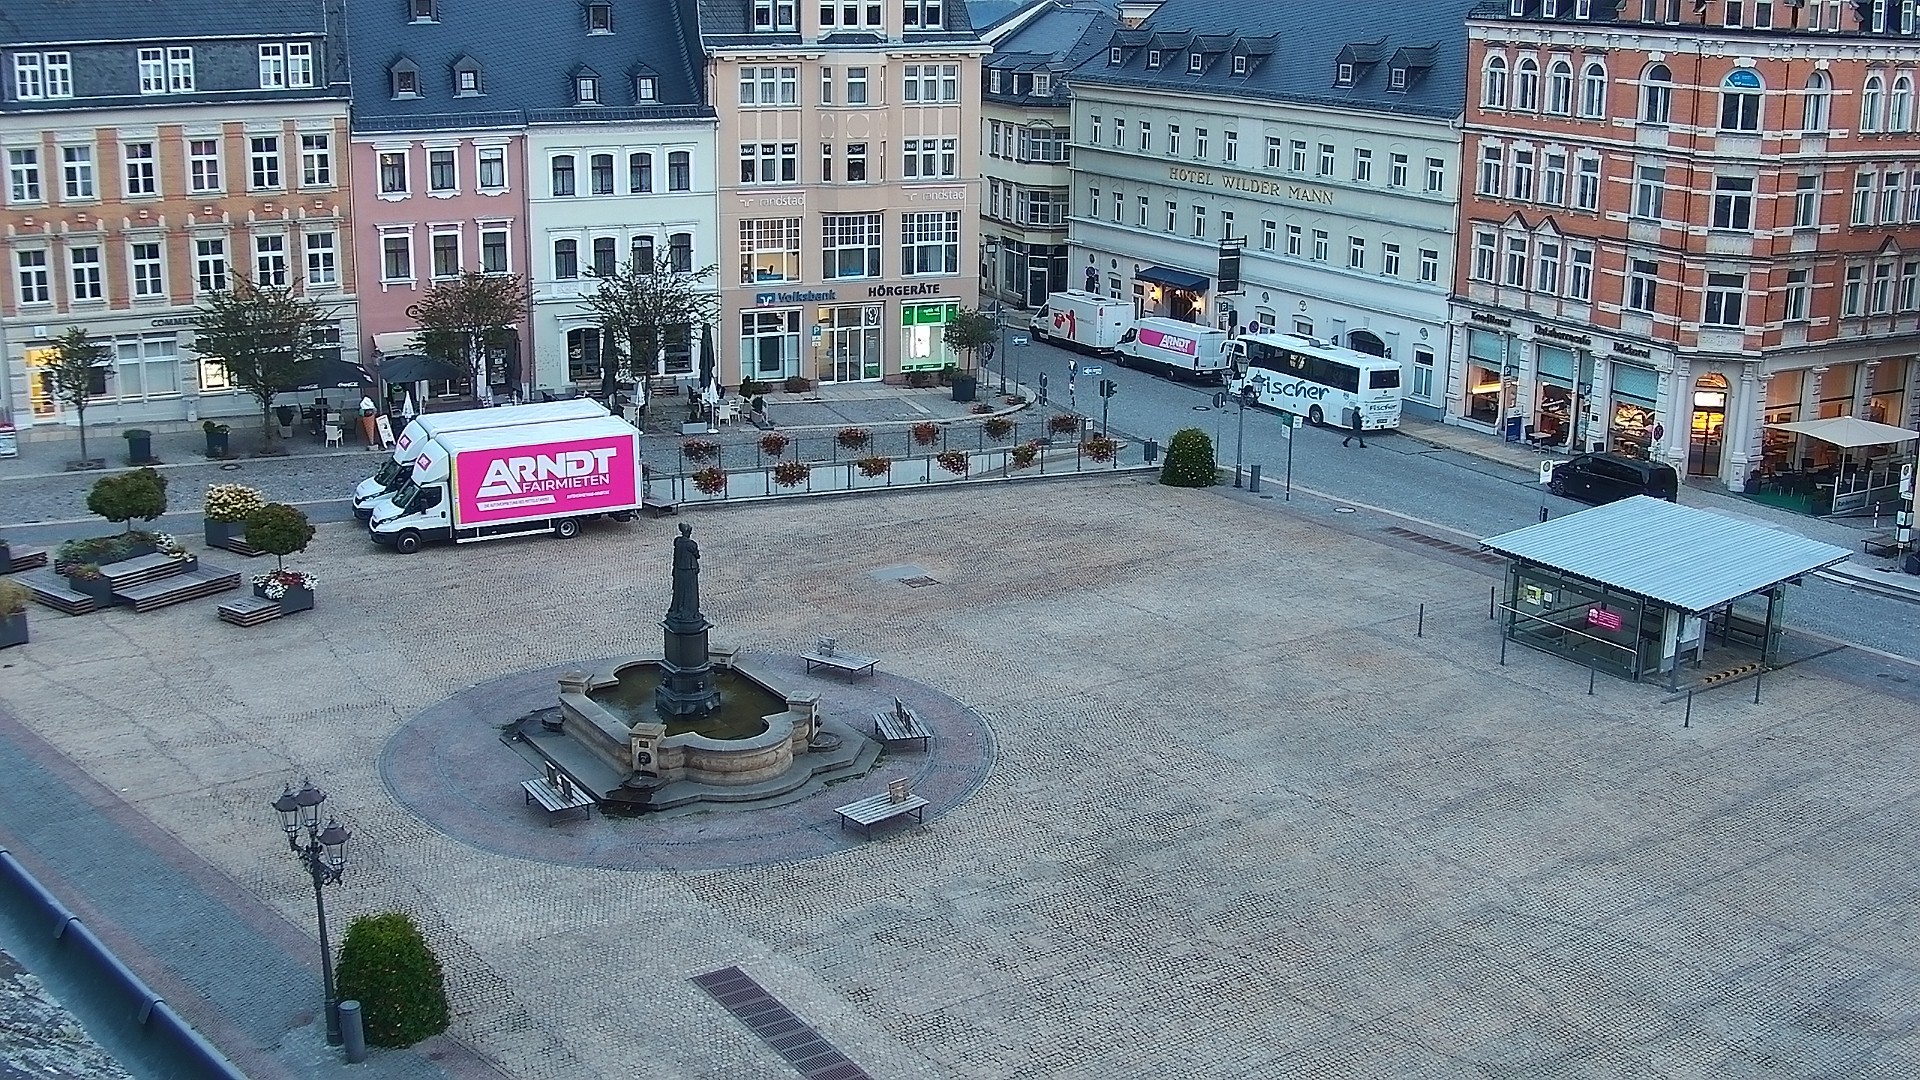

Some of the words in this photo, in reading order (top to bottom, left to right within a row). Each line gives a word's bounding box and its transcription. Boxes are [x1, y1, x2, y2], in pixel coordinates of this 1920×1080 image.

[1169, 167, 1214, 186] HOTEL
[1222, 175, 1280, 197] WILDER
[1288, 185, 1334, 206] MANN
[759, 195, 804, 206] randstad
[922, 189, 965, 201] randstad
[777, 289, 836, 303] Volksbank
[868, 283, 940, 297] HÖRGERÄTE
[1159, 334, 1191, 349] ARNDT
[1263, 376, 1331, 400] ischer
[1369, 403, 1397, 411] Fischer
[476, 447, 617, 498] ARNDT
[522, 473, 610, 493] FAIRMIETEN
